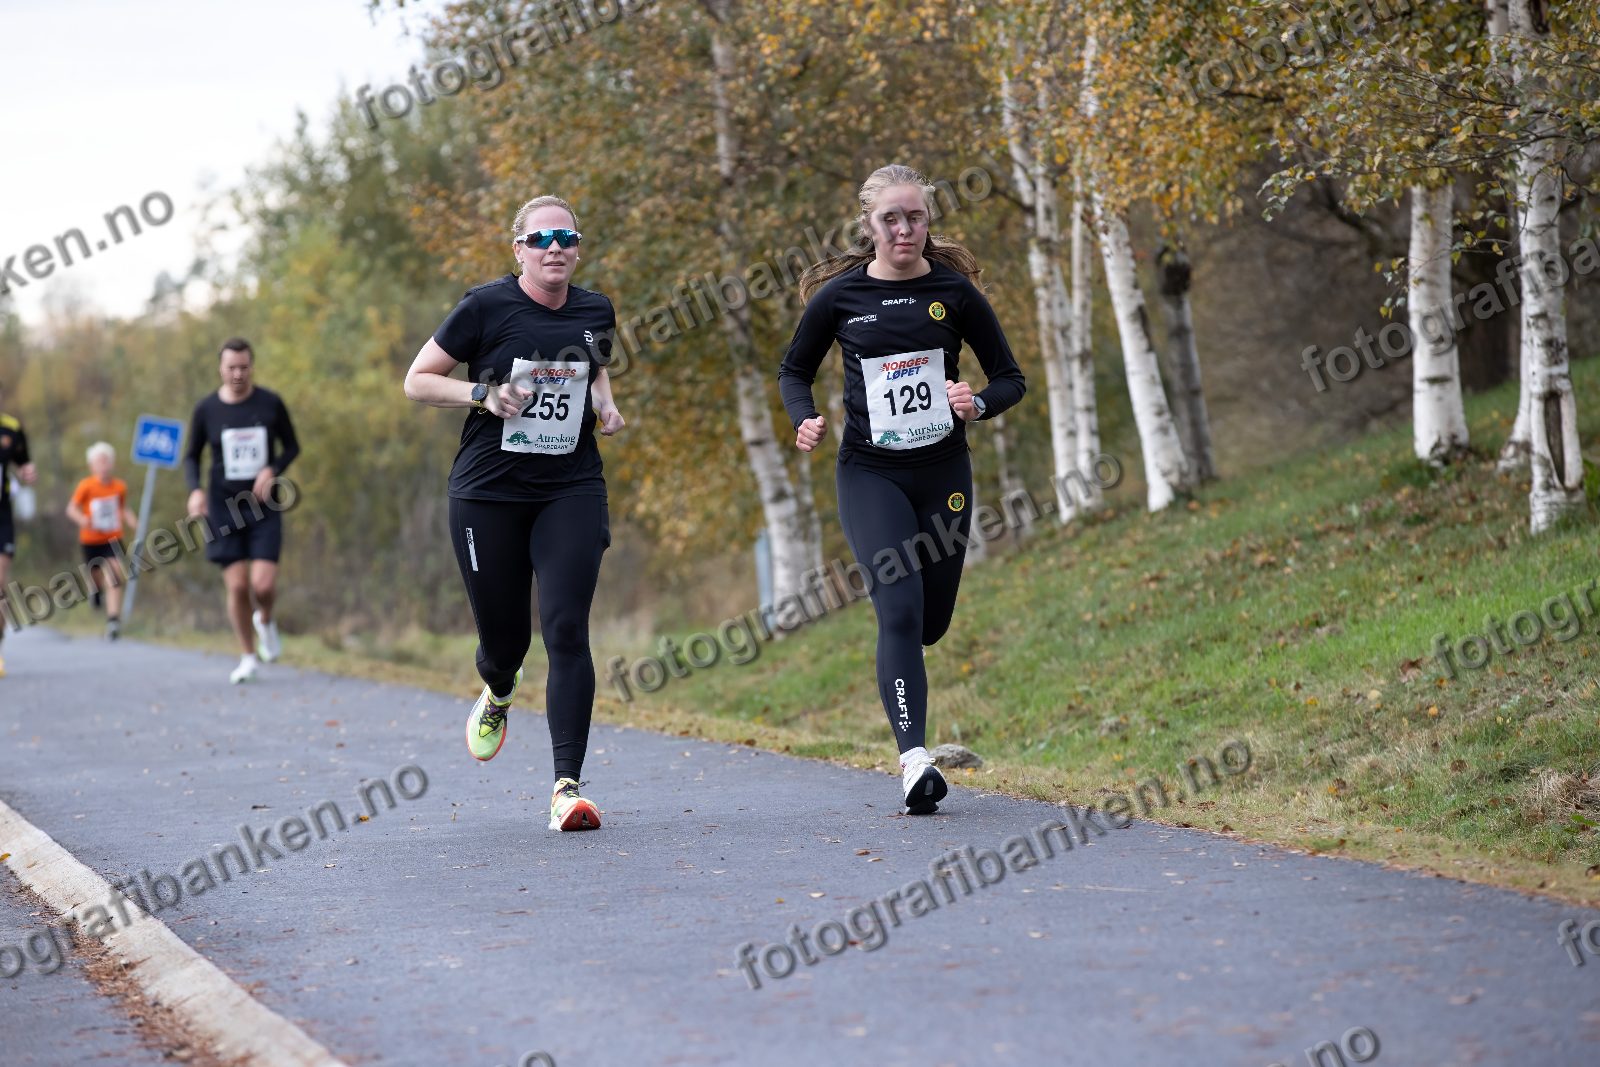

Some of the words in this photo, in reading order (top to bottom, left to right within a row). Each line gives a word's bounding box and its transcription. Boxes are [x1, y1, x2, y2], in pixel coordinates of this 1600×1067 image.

[881, 298, 909, 306] CRAFT
[881, 357, 929, 372] NORGES
[530, 368, 577, 378] NORGES
[886, 366, 921, 380] LØPET
[533, 376, 568, 386] LØPET
[521, 391, 571, 421] 255
[884, 382, 932, 416] 129
[907, 422, 951, 437] Aurskog
[535, 433, 576, 445] Aurskog
[895, 678, 909, 720] CRAFT
